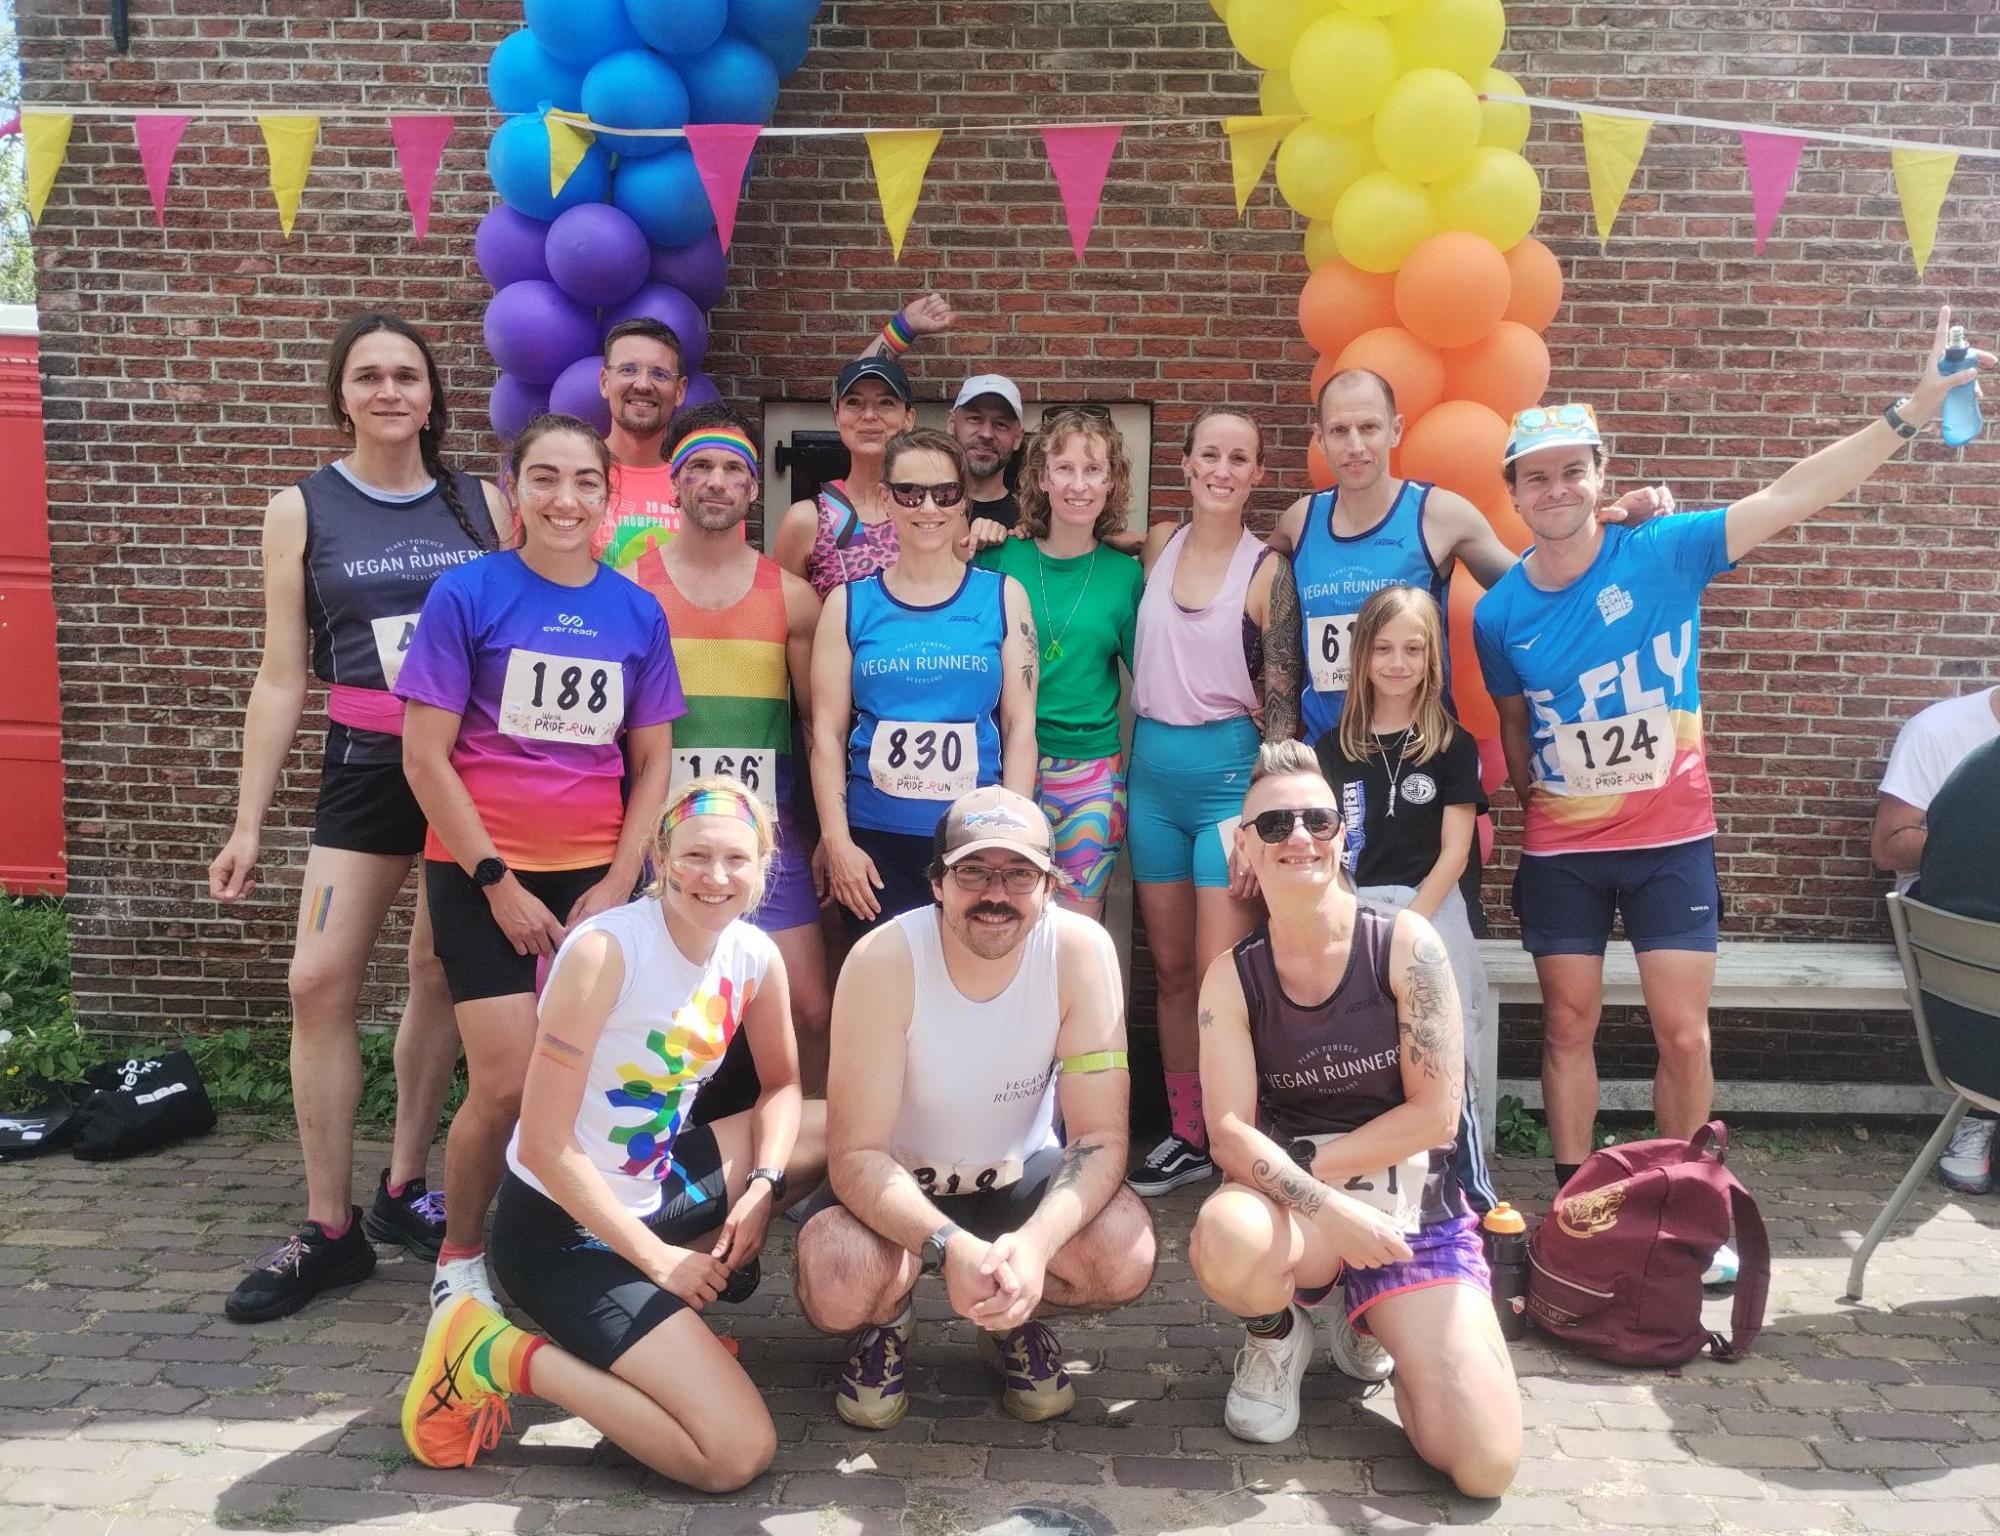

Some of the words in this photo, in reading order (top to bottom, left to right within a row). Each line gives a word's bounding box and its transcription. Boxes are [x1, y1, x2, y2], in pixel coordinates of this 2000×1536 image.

[343, 557, 404, 578] VEGAN
[1303, 582, 1339, 601] VEGAN
[860, 657, 911, 677] VEGAN
[916, 655, 989, 673] RUNNERS
[531, 661, 608, 714] 188
[534, 718, 566, 733] PRIDE
[887, 727, 962, 773] 830
[1576, 718, 1659, 769] 124
[896, 778, 925, 793] PRIDE
[1265, 1069, 1319, 1090] VEGAN
